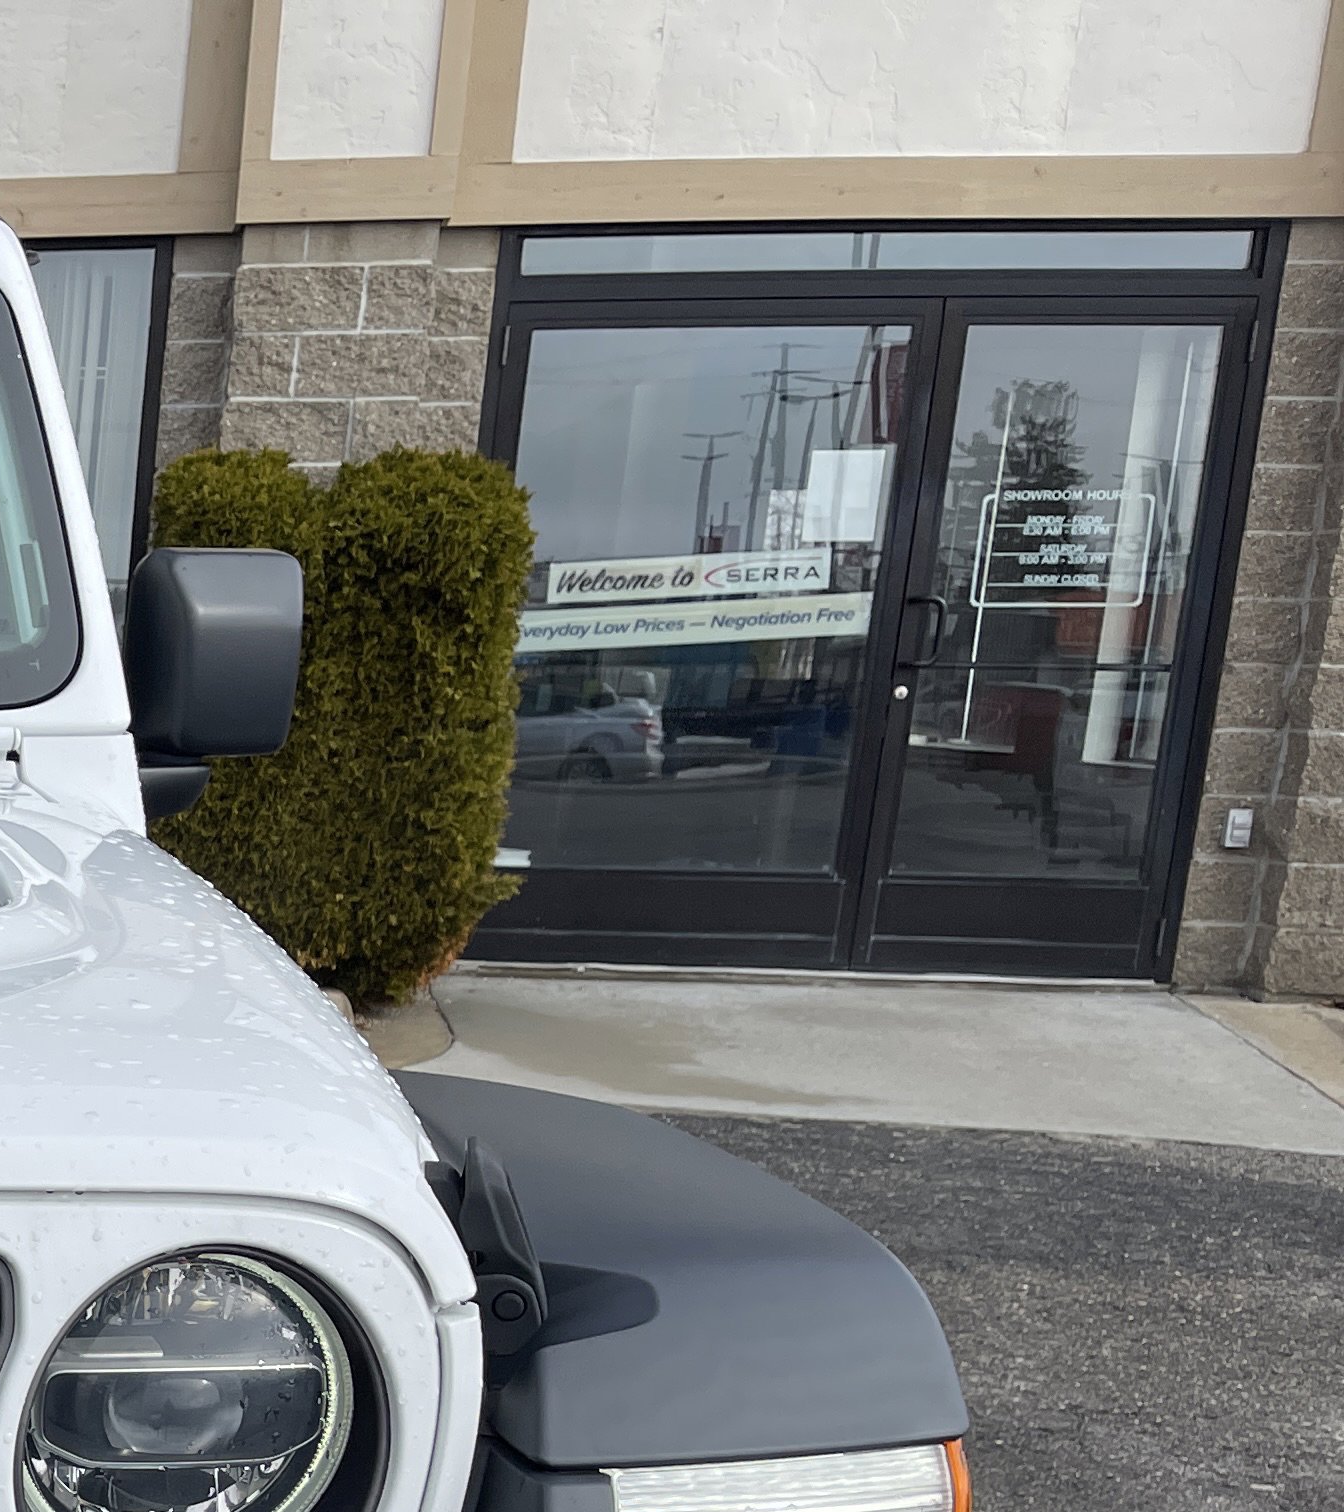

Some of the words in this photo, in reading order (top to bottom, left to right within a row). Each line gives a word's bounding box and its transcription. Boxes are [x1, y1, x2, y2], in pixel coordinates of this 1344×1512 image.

[1003, 489, 1083, 501] SHOWROOM
[1087, 489, 1133, 501] HOUR
[1026, 515, 1066, 526] MONDAY
[1040, 544, 1087, 555] SATURDAY
[555, 567, 665, 595] Welcome
[670, 565, 695, 589] to
[725, 566, 821, 584] SERRA
[1024, 574, 1060, 585] SUNDAY
[520, 623, 591, 641] veryday
[592, 620, 632, 636] Low
[633, 617, 686, 634] Prices
[710, 609, 812, 631] Negotiation
[815, 607, 856, 623] Free
